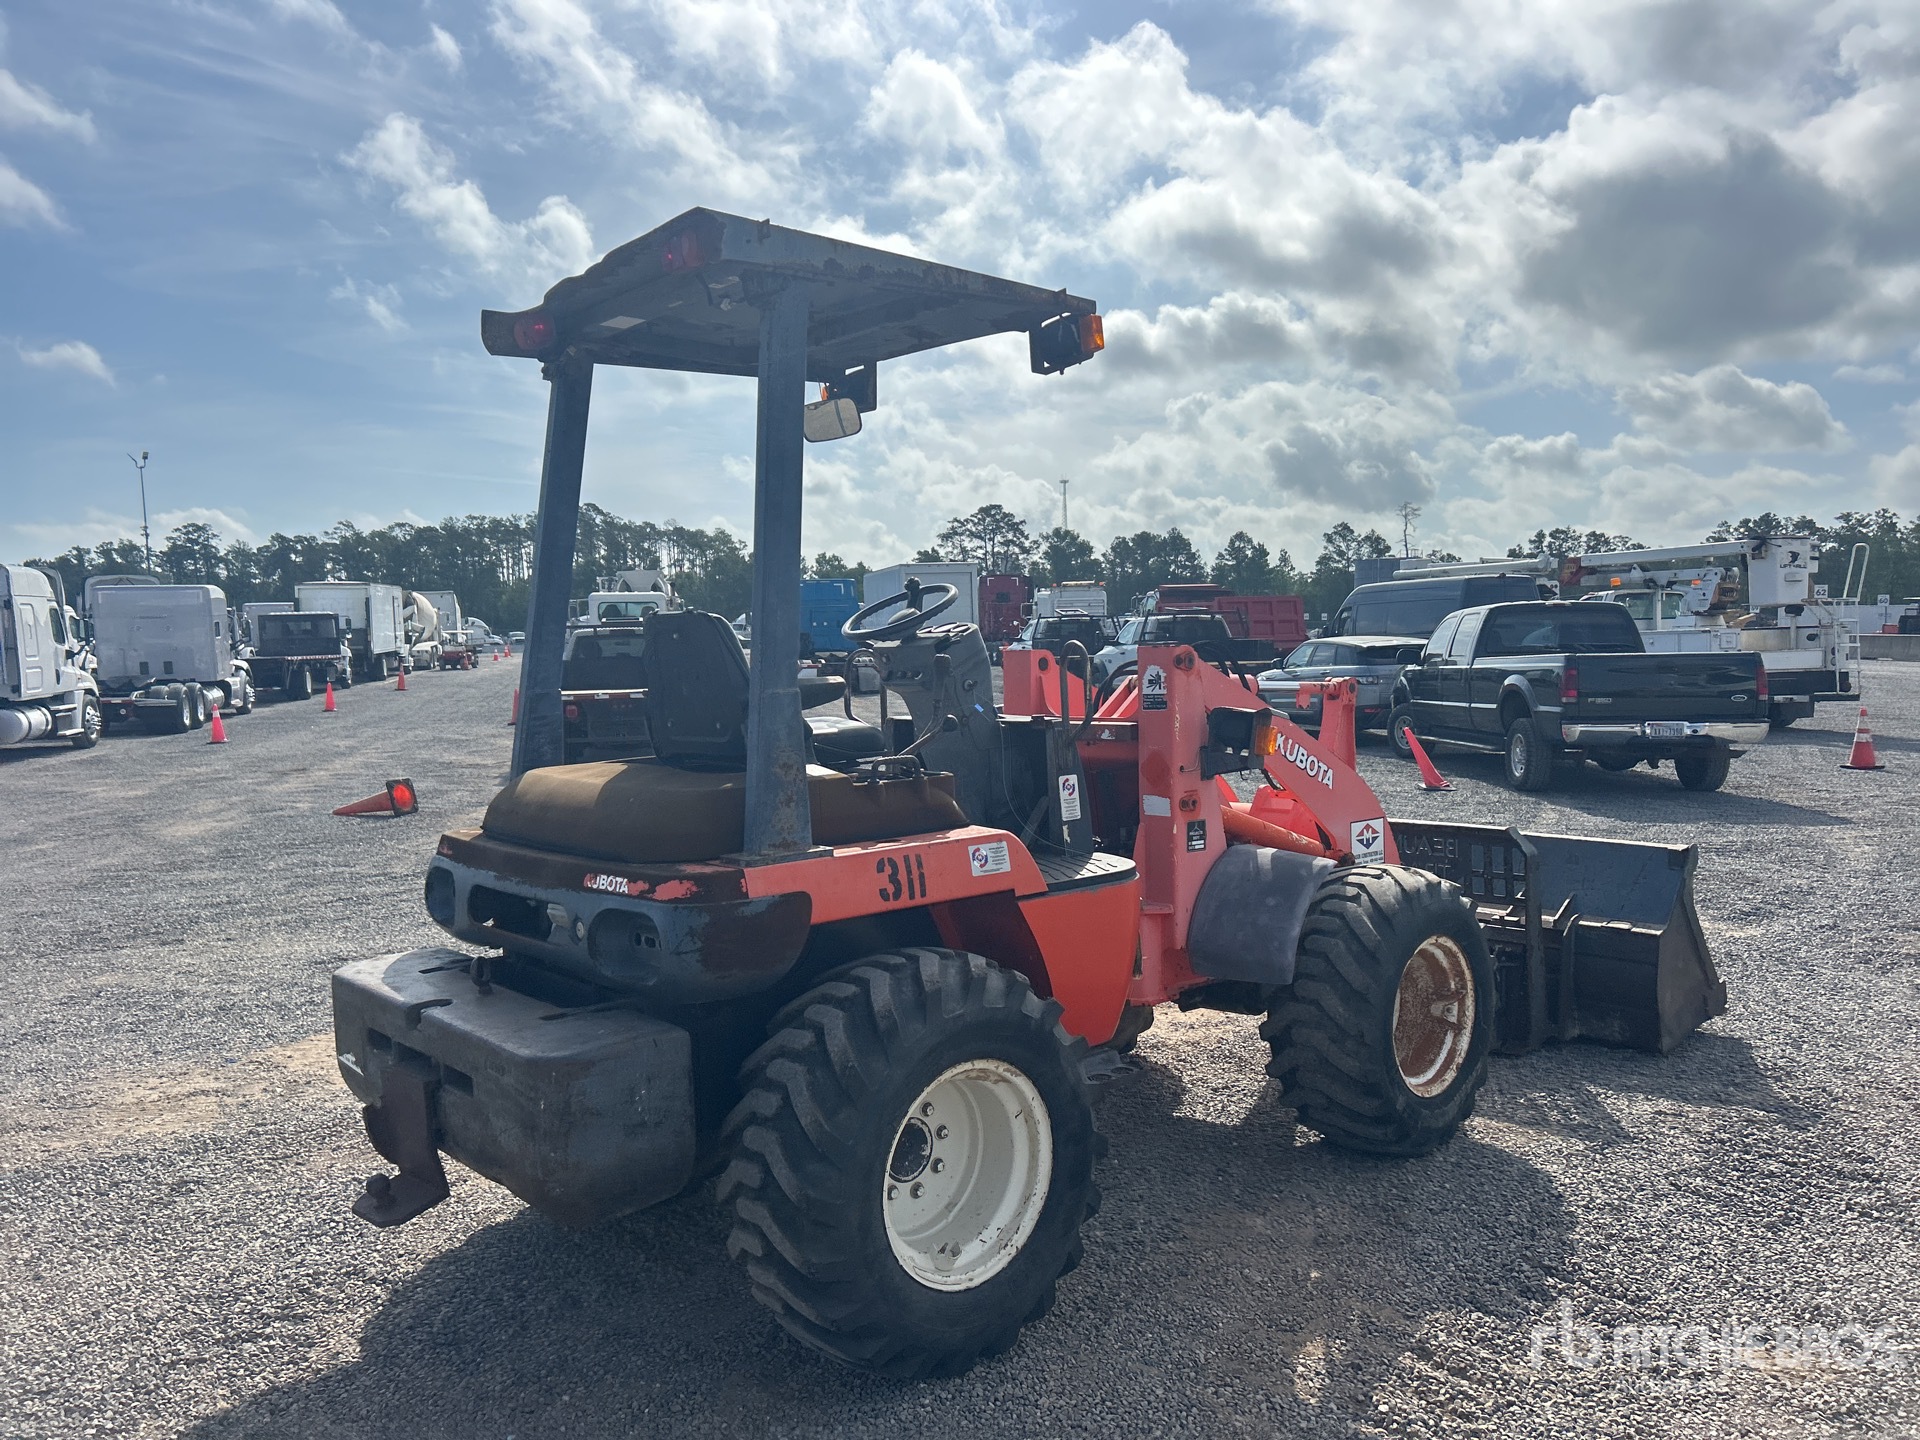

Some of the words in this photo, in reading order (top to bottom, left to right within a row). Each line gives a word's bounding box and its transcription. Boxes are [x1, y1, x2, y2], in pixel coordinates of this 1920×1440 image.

[1275, 733, 1333, 789] KUBOTA
[1364, 828, 1372, 844] M
[876, 854, 926, 901] 311
